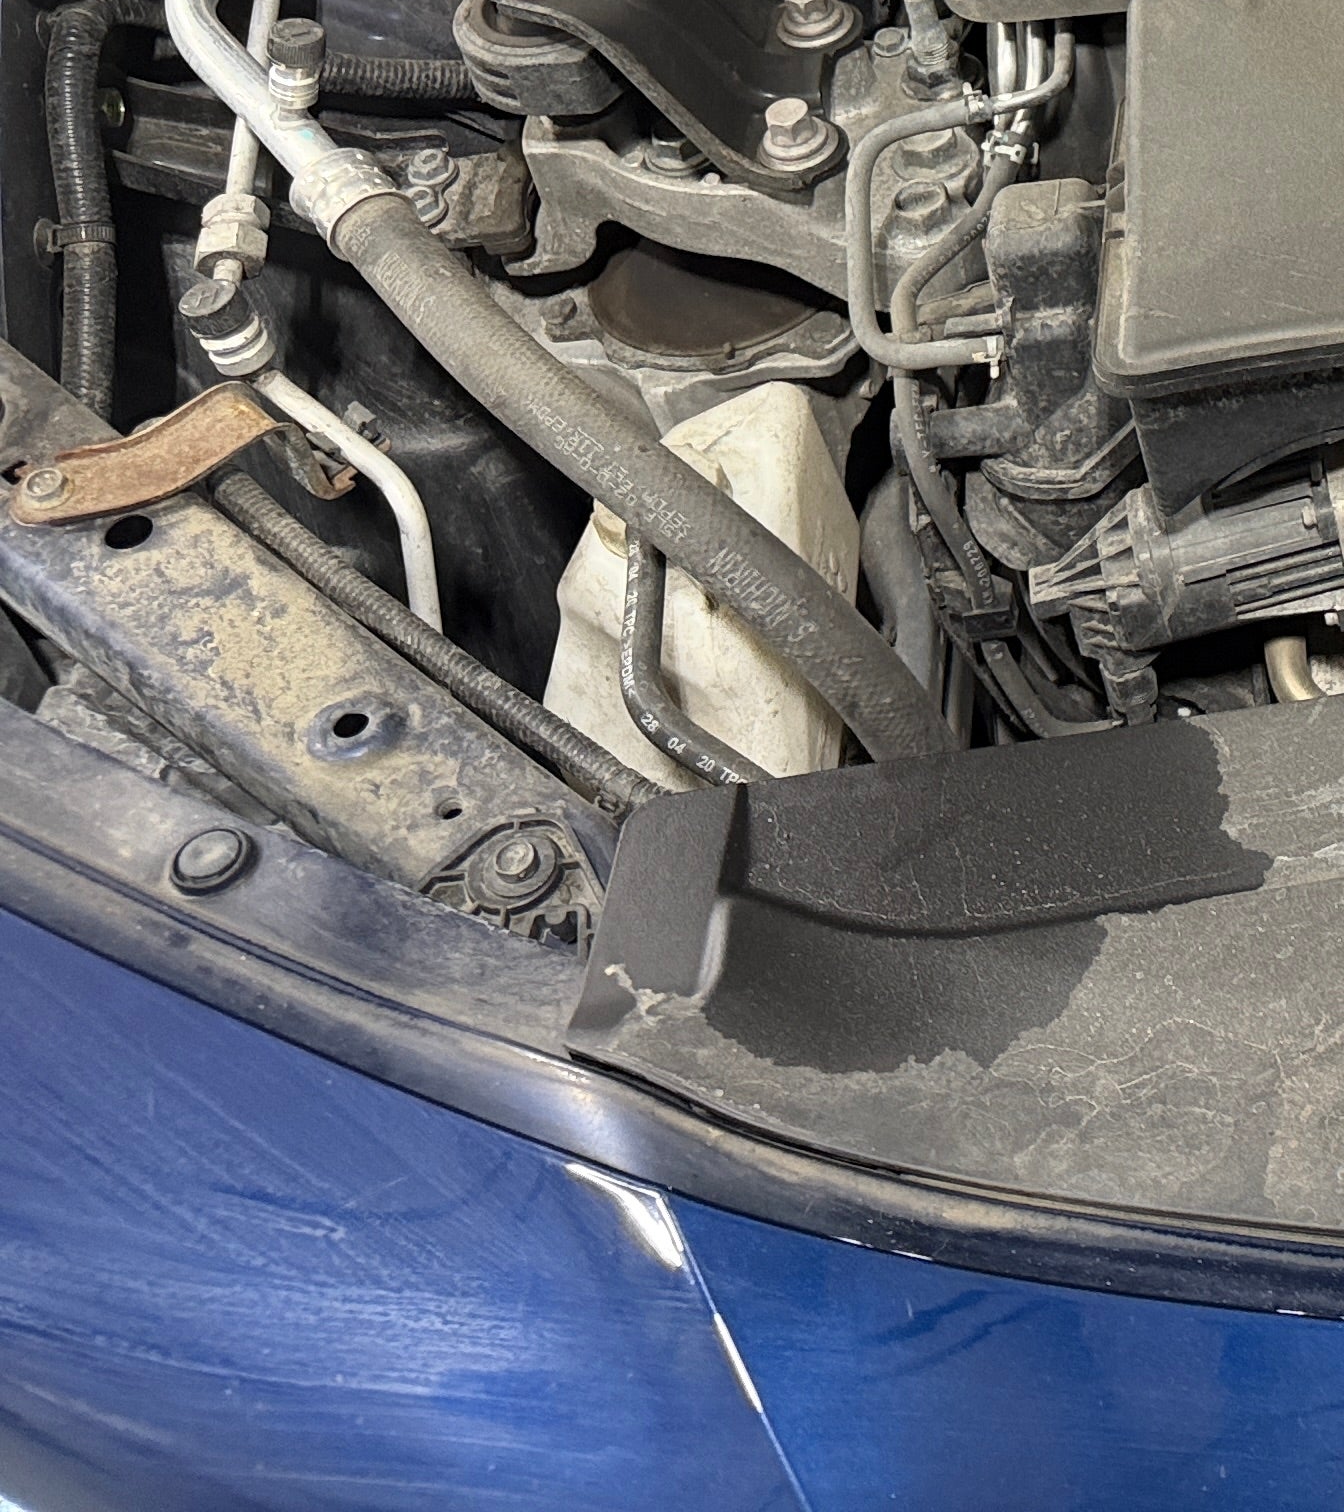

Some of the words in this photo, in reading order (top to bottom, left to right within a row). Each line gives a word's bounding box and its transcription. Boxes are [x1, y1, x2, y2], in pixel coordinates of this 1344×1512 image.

[622, 609, 638, 637] TPC
[640, 712, 660, 733] 28
[667, 737, 688, 756] 04
[696, 755, 717, 773] 20
